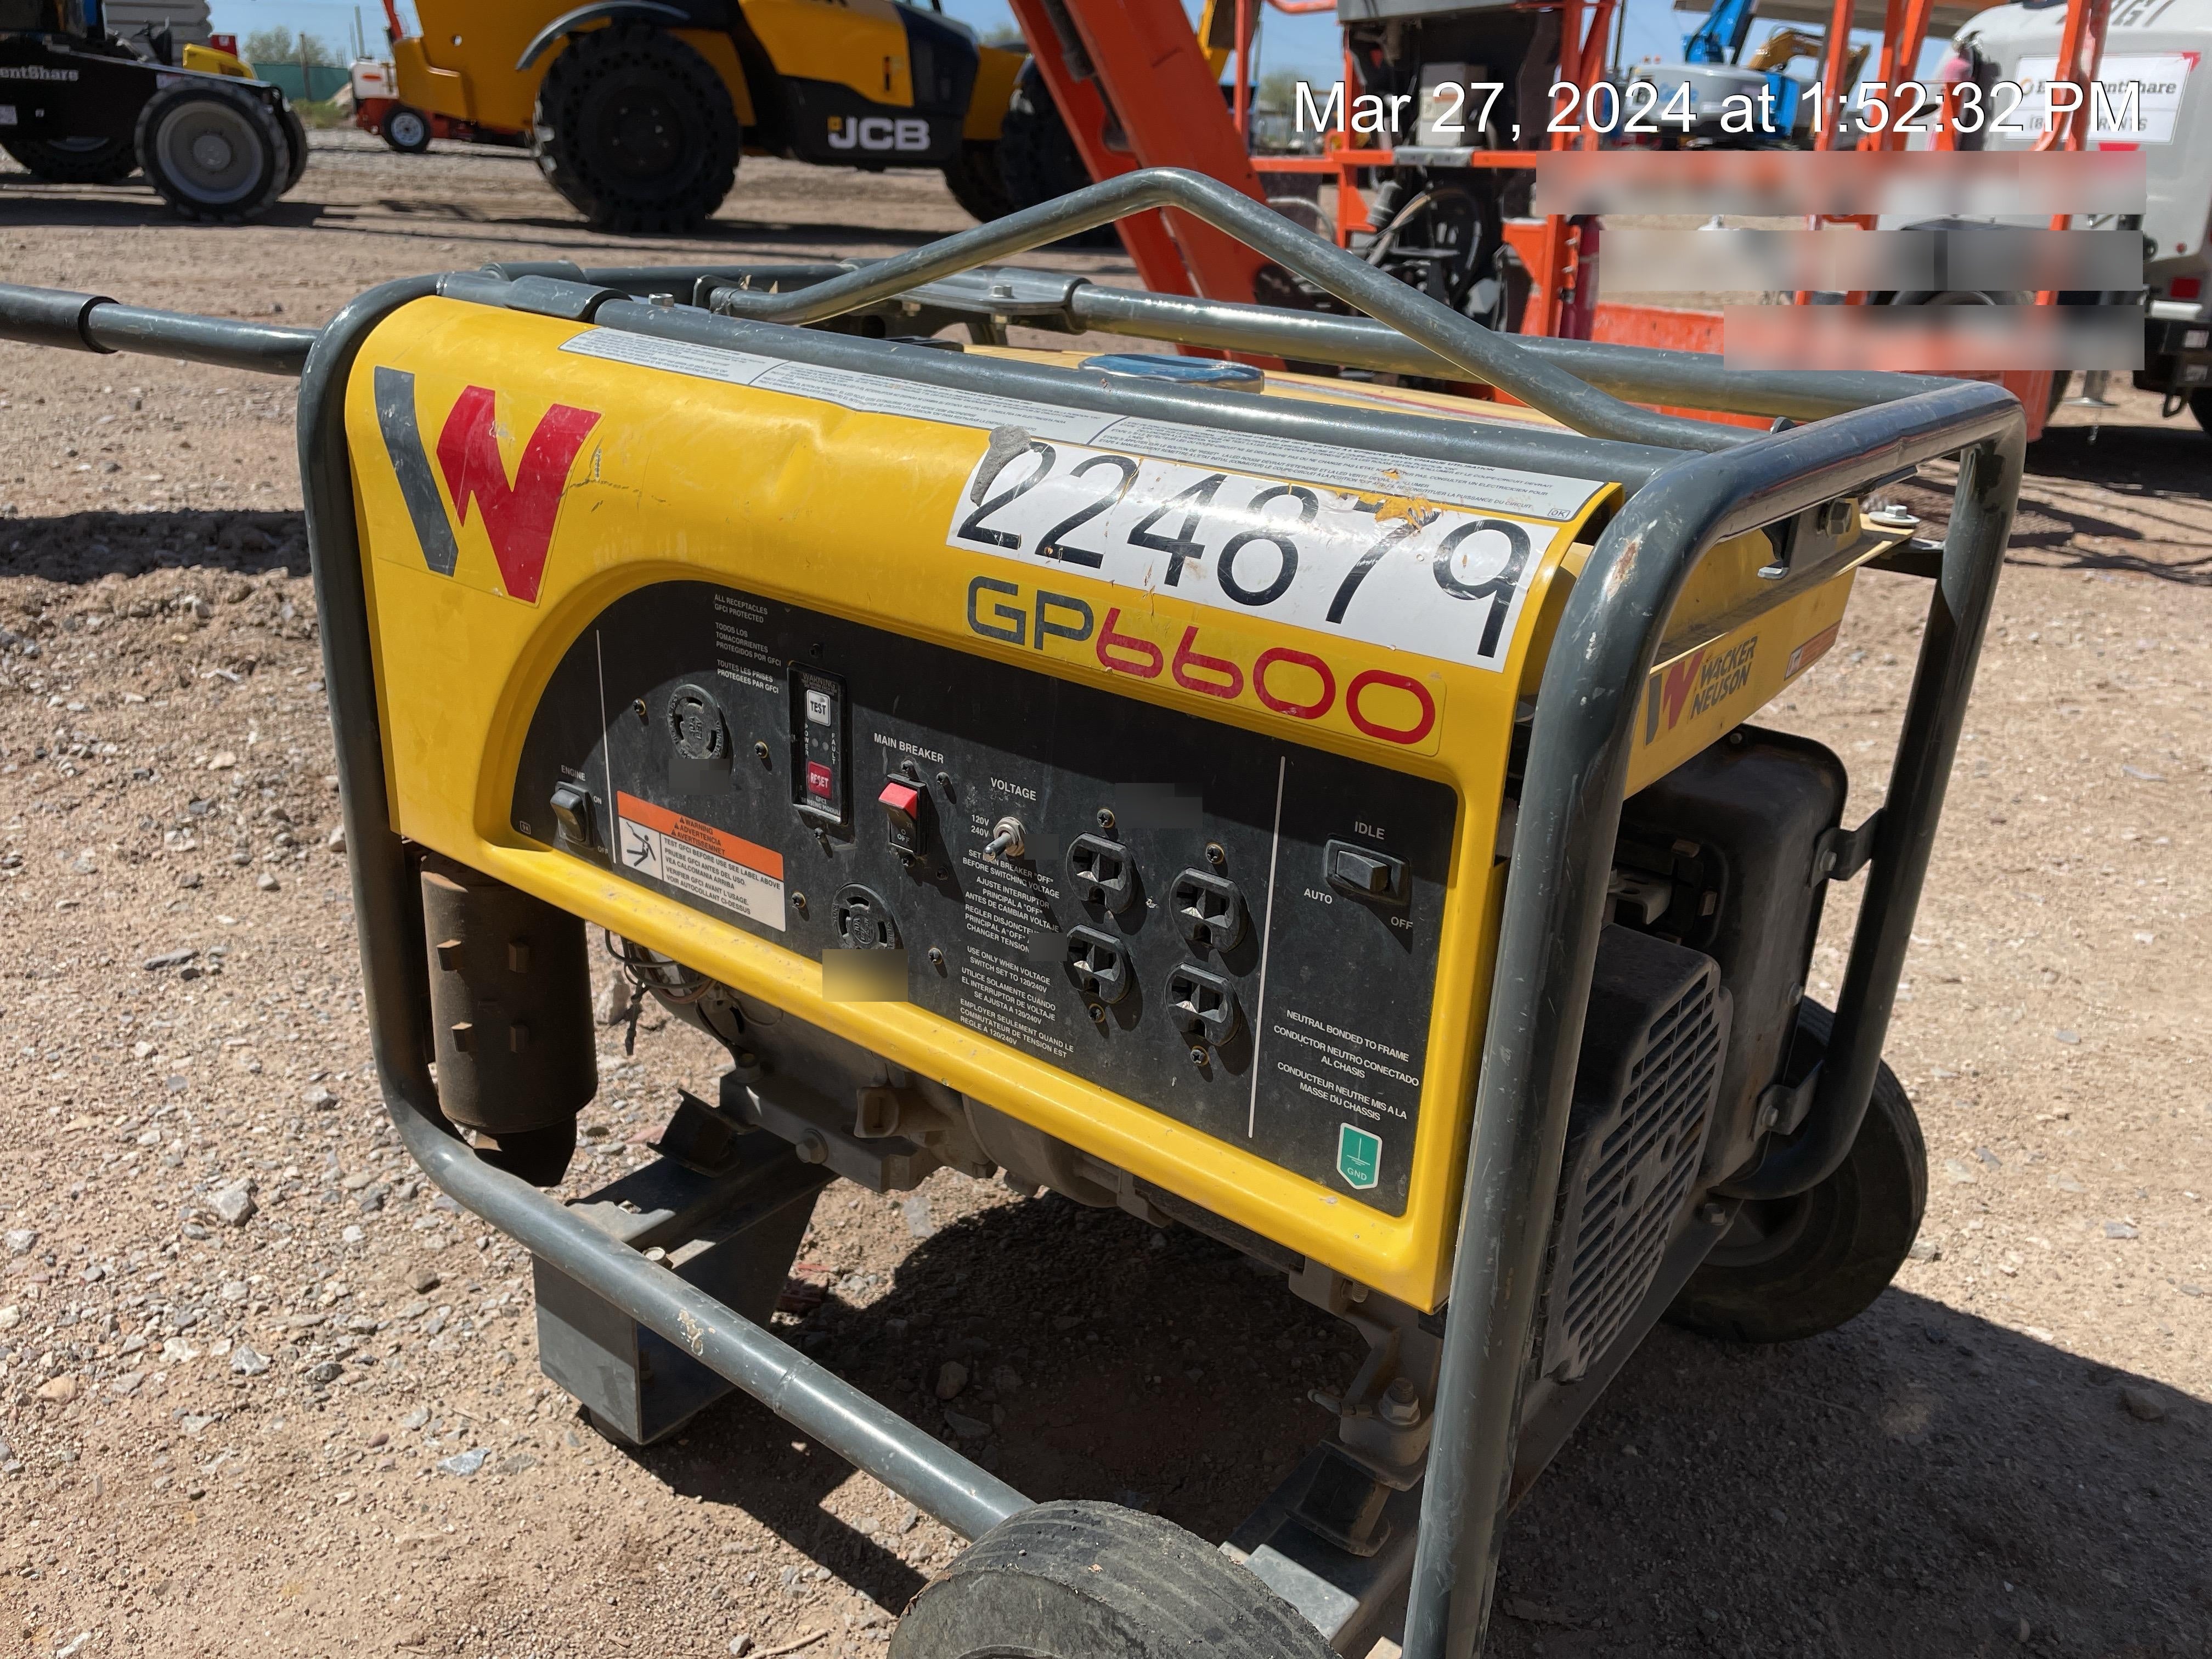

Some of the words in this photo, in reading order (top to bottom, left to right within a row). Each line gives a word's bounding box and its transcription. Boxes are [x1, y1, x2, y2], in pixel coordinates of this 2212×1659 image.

[827, 116, 930, 151] JCB
[957, 439, 1531, 658] 224879
[715, 594, 725, 603] ALL
[726, 597, 768, 615] RECEPTACLES
[715, 603, 728, 613] GFCI
[729, 608, 764, 623] PROTECTED
[715, 622, 735, 634] TODOS
[736, 628, 748, 637] LOS
[716, 631, 768, 653] TOMACORRIENTES
[716, 641, 753, 658] PROTEGIDOS
[754, 652, 766, 662] POR
[768, 657, 781, 667] GFCI
[967, 575, 1435, 745] GP6600
[1700, 635, 1758, 684] WACKER
[717, 659, 739, 672] TOUTES
[740, 667, 751, 675] LES
[752, 670, 773, 682] PRISES
[718, 669, 751, 685] PROTEGEES
[752, 679, 764, 689] PAR
[765, 684, 778, 693] GFCI
[1690, 662, 1751, 720] NEUSON
[810, 701, 826, 715] TEST
[874, 733, 896, 749] MAIN
[899, 740, 944, 764] BREAKER
[561, 765, 586, 781] ENGINE
[810, 772, 829, 788] RESET
[594, 795, 602, 805] ON
[990, 777, 1036, 802] VOLTAGE
[685, 819, 713, 836] WARNING
[971, 825, 989, 838] 240V
[972, 814, 989, 827] 120V
[1355, 821, 1385, 840] IDLE
[680, 826, 721, 846] ADVERTENCIA
[897, 833, 910, 843] OFF
[664, 838, 677, 847] TEST
[679, 843, 691, 853] GFCI
[692, 849, 714, 862] BEFORE
[716, 858, 727, 868] USE
[729, 863, 739, 873] SEE
[741, 868, 759, 881] LABEL
[665, 848, 686, 862] PRUEBE
[688, 857, 700, 868] GFCI
[701, 863, 719, 876] ANTES
[721, 871, 731, 881] DEL
[665, 857, 676, 866] VEA
[677, 861, 712, 881] CALCOMANIA
[714, 876, 735, 889] ARRIBA
[969, 849, 981, 860] SET
[1000, 861, 1032, 878] BREAKER
[667, 867, 690, 881] VERIFIER
[691, 876, 703, 888] GFCI
[705, 882, 722, 894] AVANT
[963, 857, 989, 873] BEFORE
[990, 867, 1027, 887] SWITCHING
[1028, 883, 1059, 898] VOLTAGE
[667, 875, 679, 885] VOIR
[680, 880, 719, 901] AUTOCOLLANT
[721, 896, 751, 915] CI-DESSUS
[977, 876, 1002, 891] AJUSTE
[1003, 886, 1049, 909] INTERRUPTOR
[983, 888, 1015, 906] PRINCIPAL
[1017, 900, 1022, 909] A
[1304, 888, 1333, 904] AUTO
[965, 891, 986, 905] ANTES
[988, 901, 996, 909] DE
[998, 904, 1028, 921] CAMBIAR
[1030, 915, 1059, 933] VOLTAJE
[965, 913, 1000, 932] PRINCIPAL
[966, 904, 992, 920] REGLER
[1390, 916, 1413, 930] OFF
[967, 923, 999, 942] CHANGER
[1001, 936, 1029, 953] TENSION
[967, 946, 980, 956] USE
[981, 951, 997, 963] ONLY
[1000, 958, 1019, 972] WHEN
[1020, 967, 1050, 985] VOLTAGE
[970, 956, 995, 972] SWITCH
[996, 968, 1008, 978] SET
[1020, 977, 1047, 994] 120/240V
[962, 967, 985, 981] UTILICE
[986, 977, 1026, 999] SOLAMENTE
[1027, 994, 1056, 1011] CUANDO
[962, 977, 969, 985] EL
[970, 980, 1015, 1004] INTERRUPTOR
[1017, 999, 1025, 1008] DE
[1027, 1003, 1056, 1021] VOLTAJE
[974, 991, 983, 1000] SE
[984, 996, 1008, 1011] AJUSTA
[1015, 1008, 1042, 1025] 120/240V
[960, 998, 996, 1018] EMPLOYER
[997, 1014, 1037, 1036] SEULEMENT
[1039, 1032, 1063, 1048] QUAND
[1065, 1043, 1074, 1053] LE
[960, 1016, 982, 1030] REGLE
[990, 1029, 1017, 1045] 120/240V
[960, 1008, 1010, 1034] COMMUTATEUR
[1012, 1030, 1021, 1039] DE
[1023, 1035, 1052, 1052] TENSION
[1053, 1048, 1067, 1058] EST
[1286, 1009, 1325, 1031] NEUTRAL
[1327, 1025, 1363, 1045] BONDED
[1364, 1038, 1376, 1049] TO
[1378, 1043, 1409, 1063] FRAME
[1273, 1025, 1325, 1051] CONDUCTOR
[1327, 1042, 1363, 1065] NEUTRO
[1364, 1059, 1419, 1087] CONECTADO
[1321, 1055, 1333, 1066] AL
[1334, 1060, 1365, 1079] CHASIS
[1277, 1062, 1334, 1090] CONDUCTEUR
[1335, 1084, 1370, 1105] NEUTRE
[1371, 1098, 1386, 1111] MIS
[1387, 1105, 1394, 1114] A
[1395, 1110, 1407, 1120] LA
[1300, 1082, 1329, 1100] MASSE
[1330, 1094, 1342, 1106] DU
[1344, 1100, 1381, 1121] CHASSIS
[1347, 1167, 1367, 1181] GND
